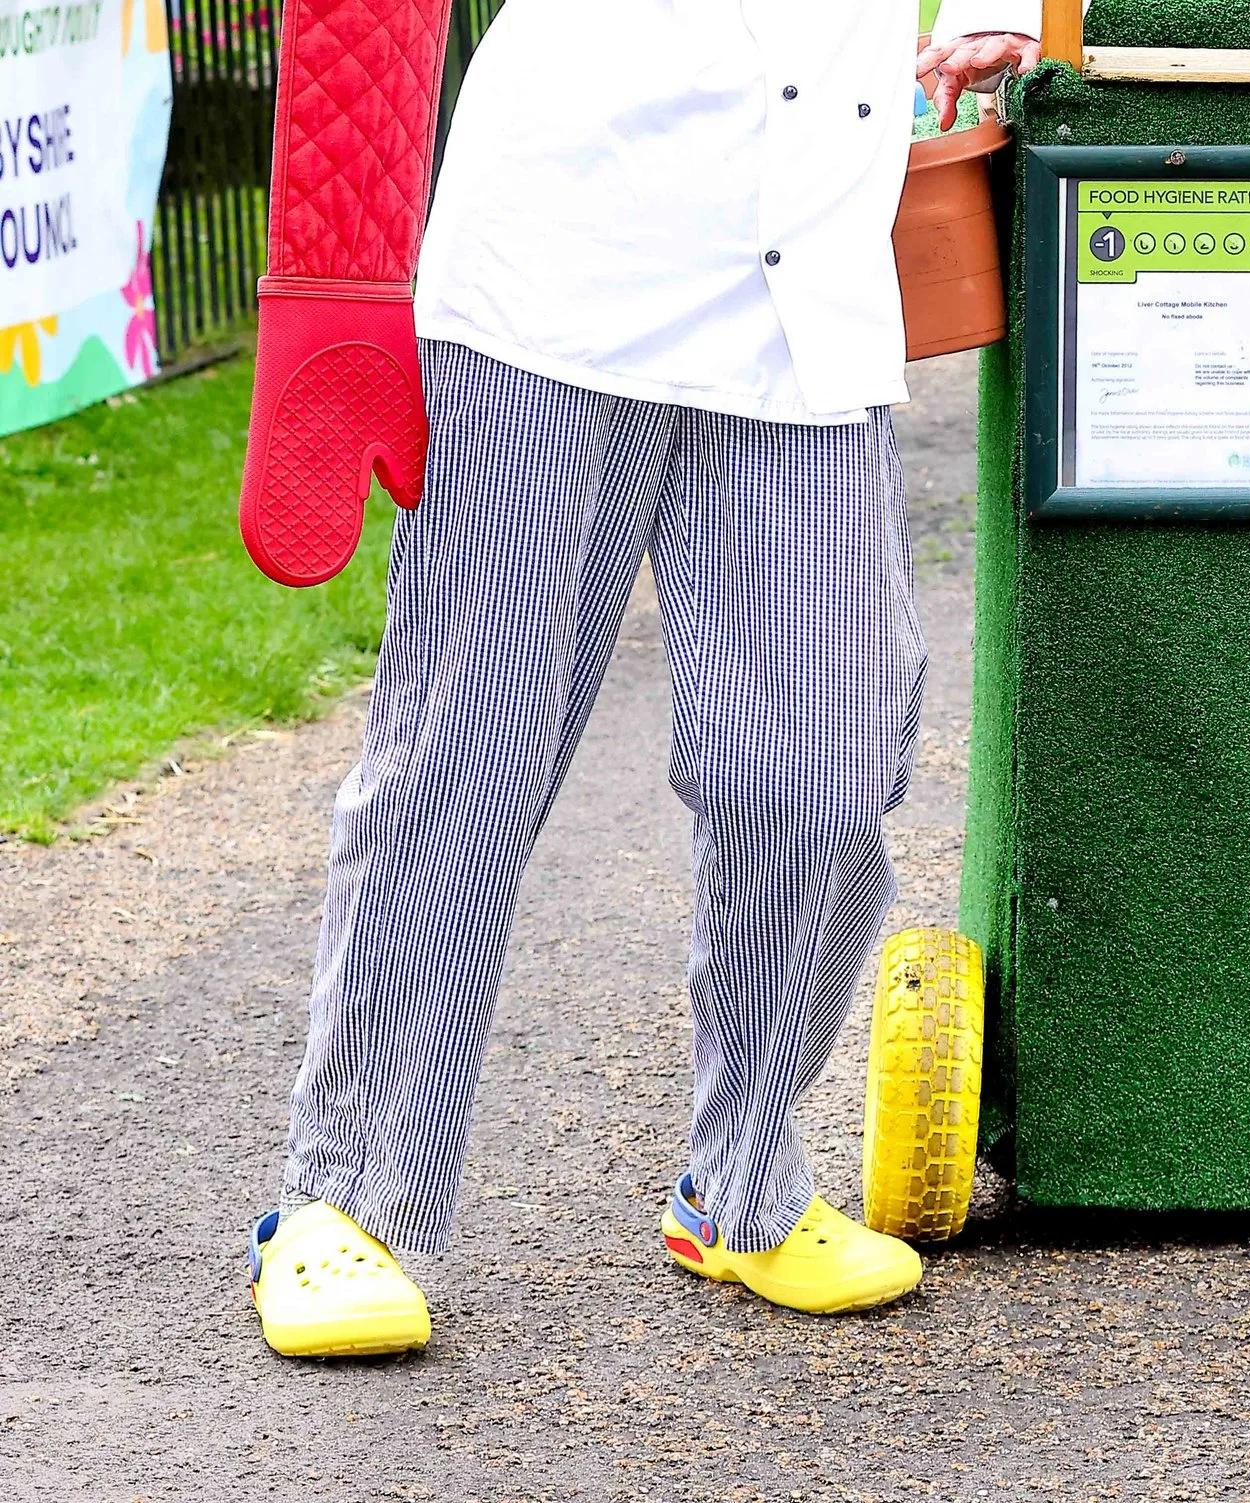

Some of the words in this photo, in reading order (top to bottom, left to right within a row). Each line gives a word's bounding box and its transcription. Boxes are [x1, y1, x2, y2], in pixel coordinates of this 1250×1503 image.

[1089, 190, 1139, 204] FOOD
[1144, 190, 1214, 204] HYGIENE
[1154, 301, 1180, 309] Cottage
